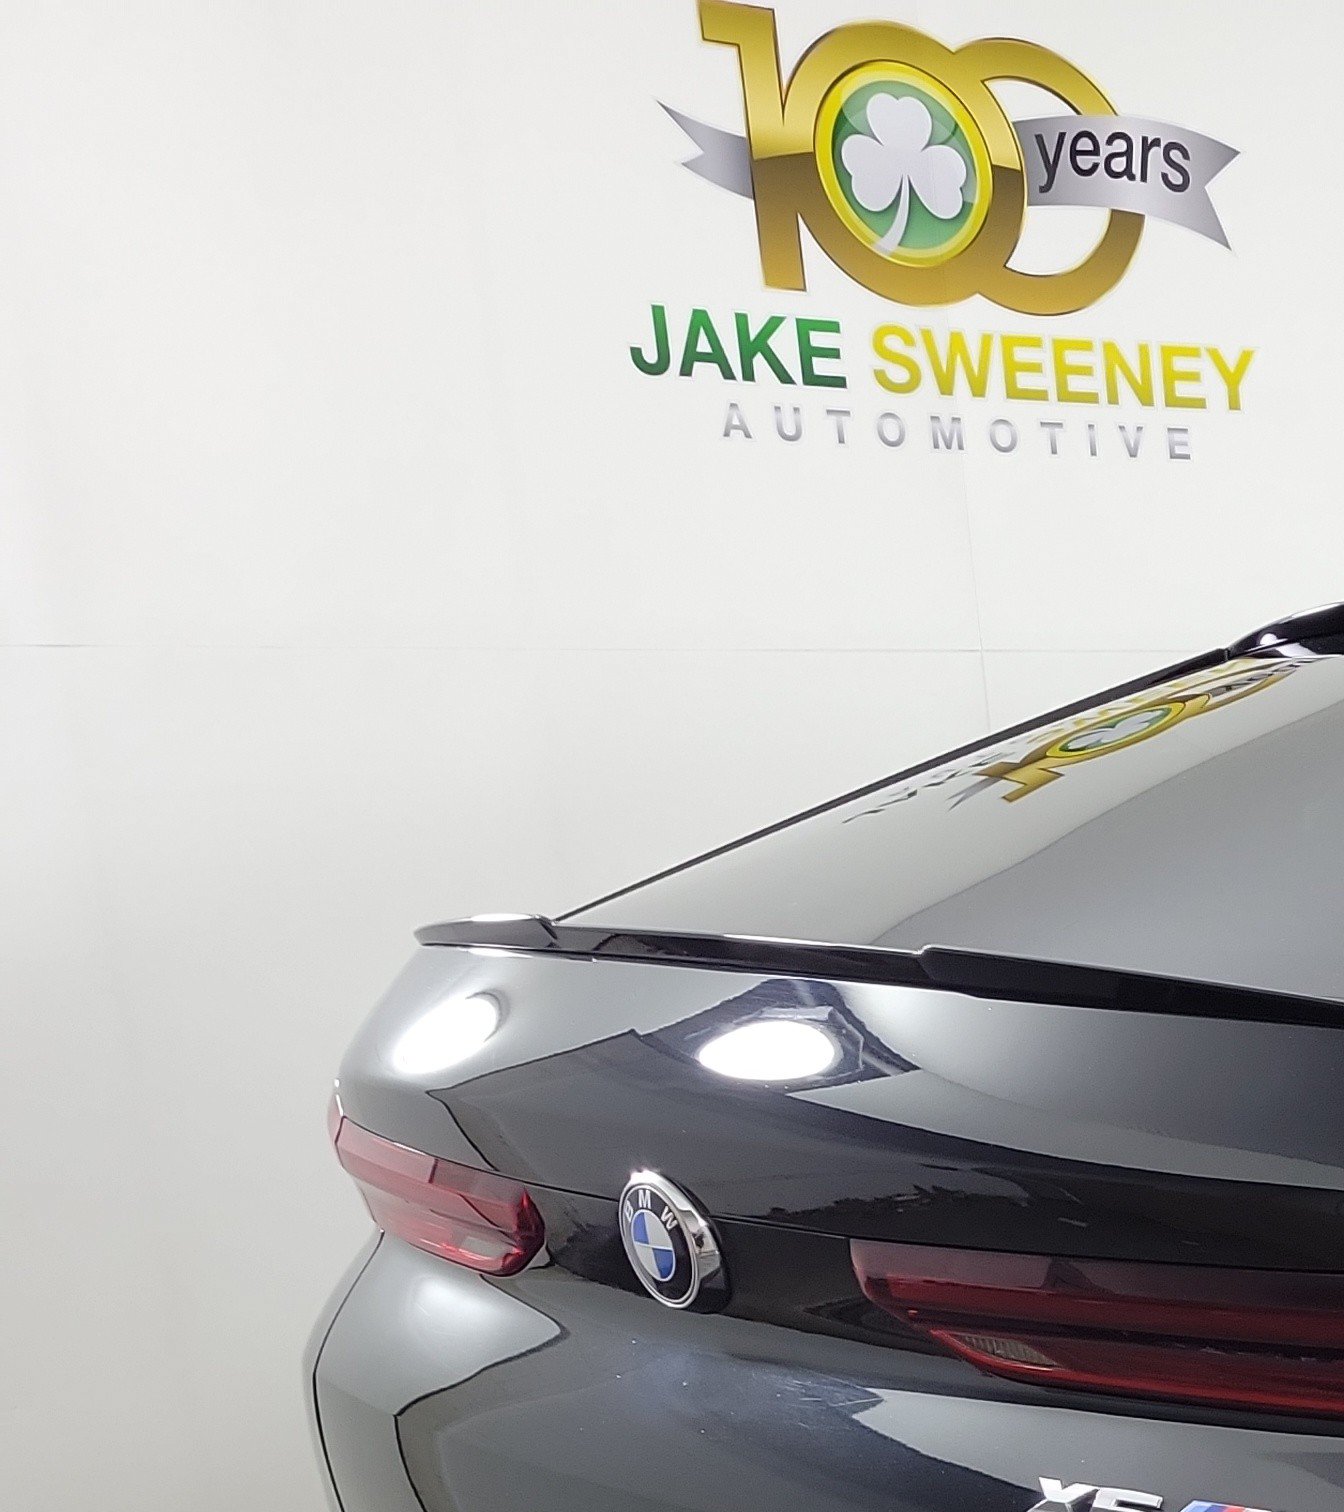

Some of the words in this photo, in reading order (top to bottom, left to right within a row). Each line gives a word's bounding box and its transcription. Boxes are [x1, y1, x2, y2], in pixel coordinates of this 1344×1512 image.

[694, 0, 1146, 317] 100
[1034, 129, 1191, 194] years
[629, 304, 847, 389] JAKE
[871, 324, 1255, 411] SWEENEY
[722, 402, 1192, 460] AUTOMOTIVE
[624, 1189, 678, 1230] BMW
